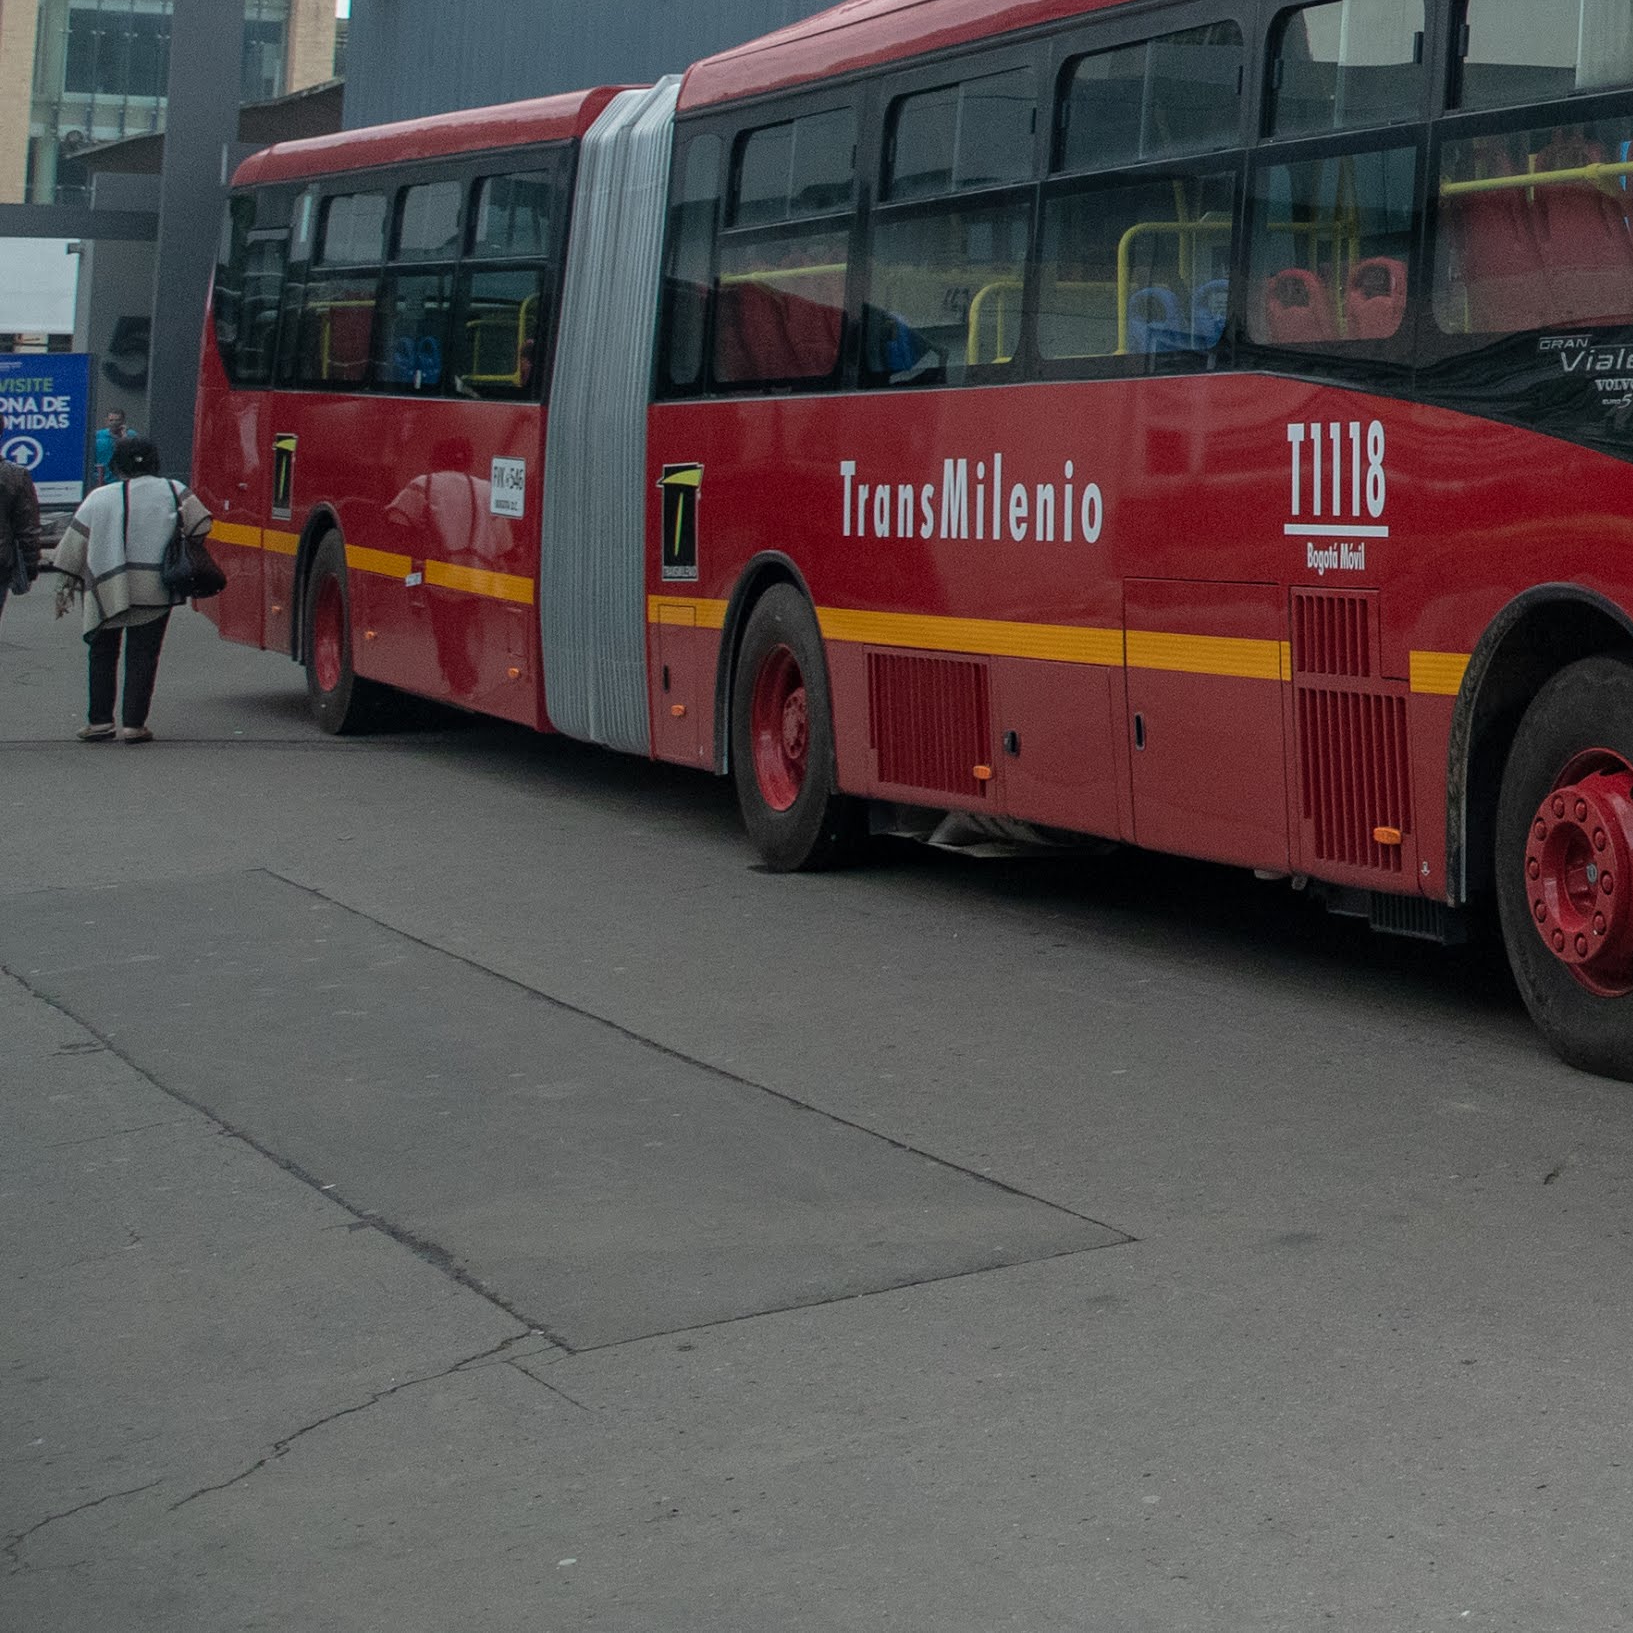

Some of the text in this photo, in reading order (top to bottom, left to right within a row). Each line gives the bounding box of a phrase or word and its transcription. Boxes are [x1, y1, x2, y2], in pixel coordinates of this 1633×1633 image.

[1539, 338, 1589, 350] GRAN
[0, 377, 54, 393] VISITE
[43, 395, 71, 412] DE
[1287, 419, 1386, 518] T1118
[840, 452, 1103, 544] TransMilenio
[1307, 541, 1365, 576] Bogotá Móvil
